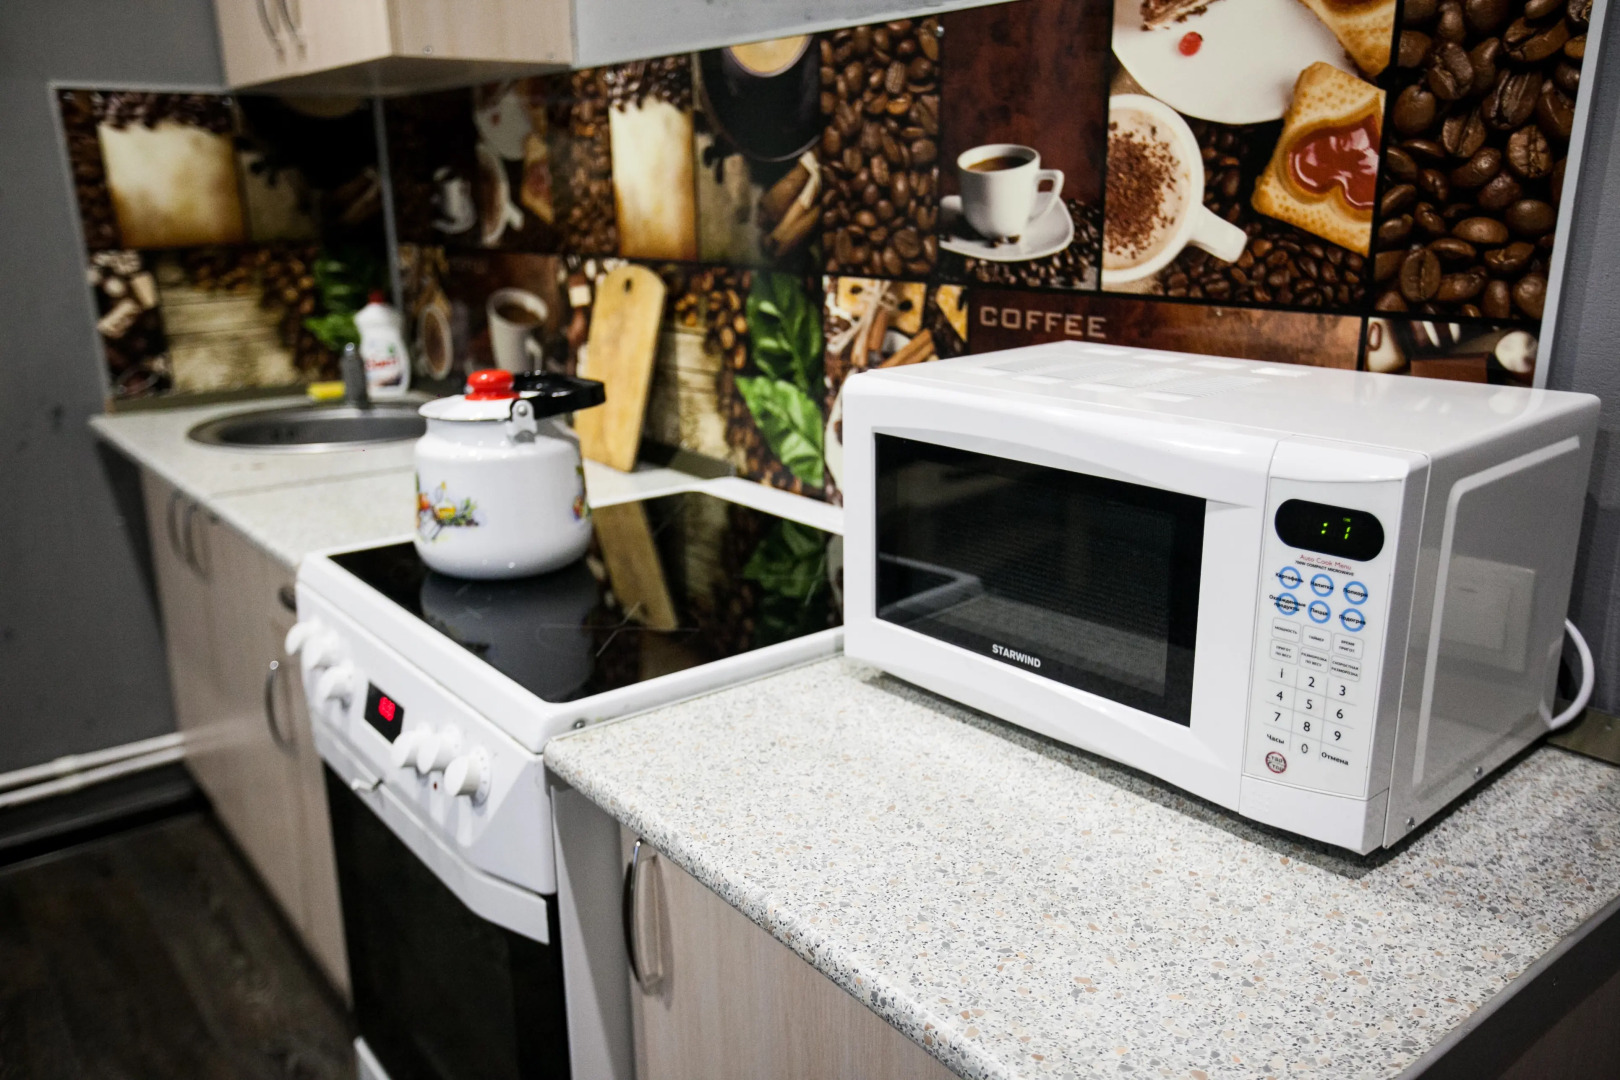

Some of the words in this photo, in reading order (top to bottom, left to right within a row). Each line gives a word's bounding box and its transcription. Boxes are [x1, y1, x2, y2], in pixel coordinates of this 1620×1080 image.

[980, 305, 1107, 339] COFFEE
[1300, 554, 1315, 562] Auto
[1316, 557, 1333, 566] Cook
[1335, 561, 1352, 570] Menu
[1306, 562, 1327, 571] COMPACT
[1327, 567, 1354, 577] MICROWAVE
[992, 643, 1041, 668] STARWIND
[1308, 676, 1315, 688] 2
[1276, 691, 1283, 701] 4
[1339, 685, 1346, 696] 3
[1305, 699, 1312, 710] 5
[1274, 711, 1281, 722] 7
[1336, 709, 1343, 719] 6
[1303, 721, 1310, 732] 8
[1266, 733, 1285, 745] Часы
[1334, 730, 1341, 741] 9
[1301, 743, 1308, 754] 0
[1321, 751, 1349, 766] Отмена
